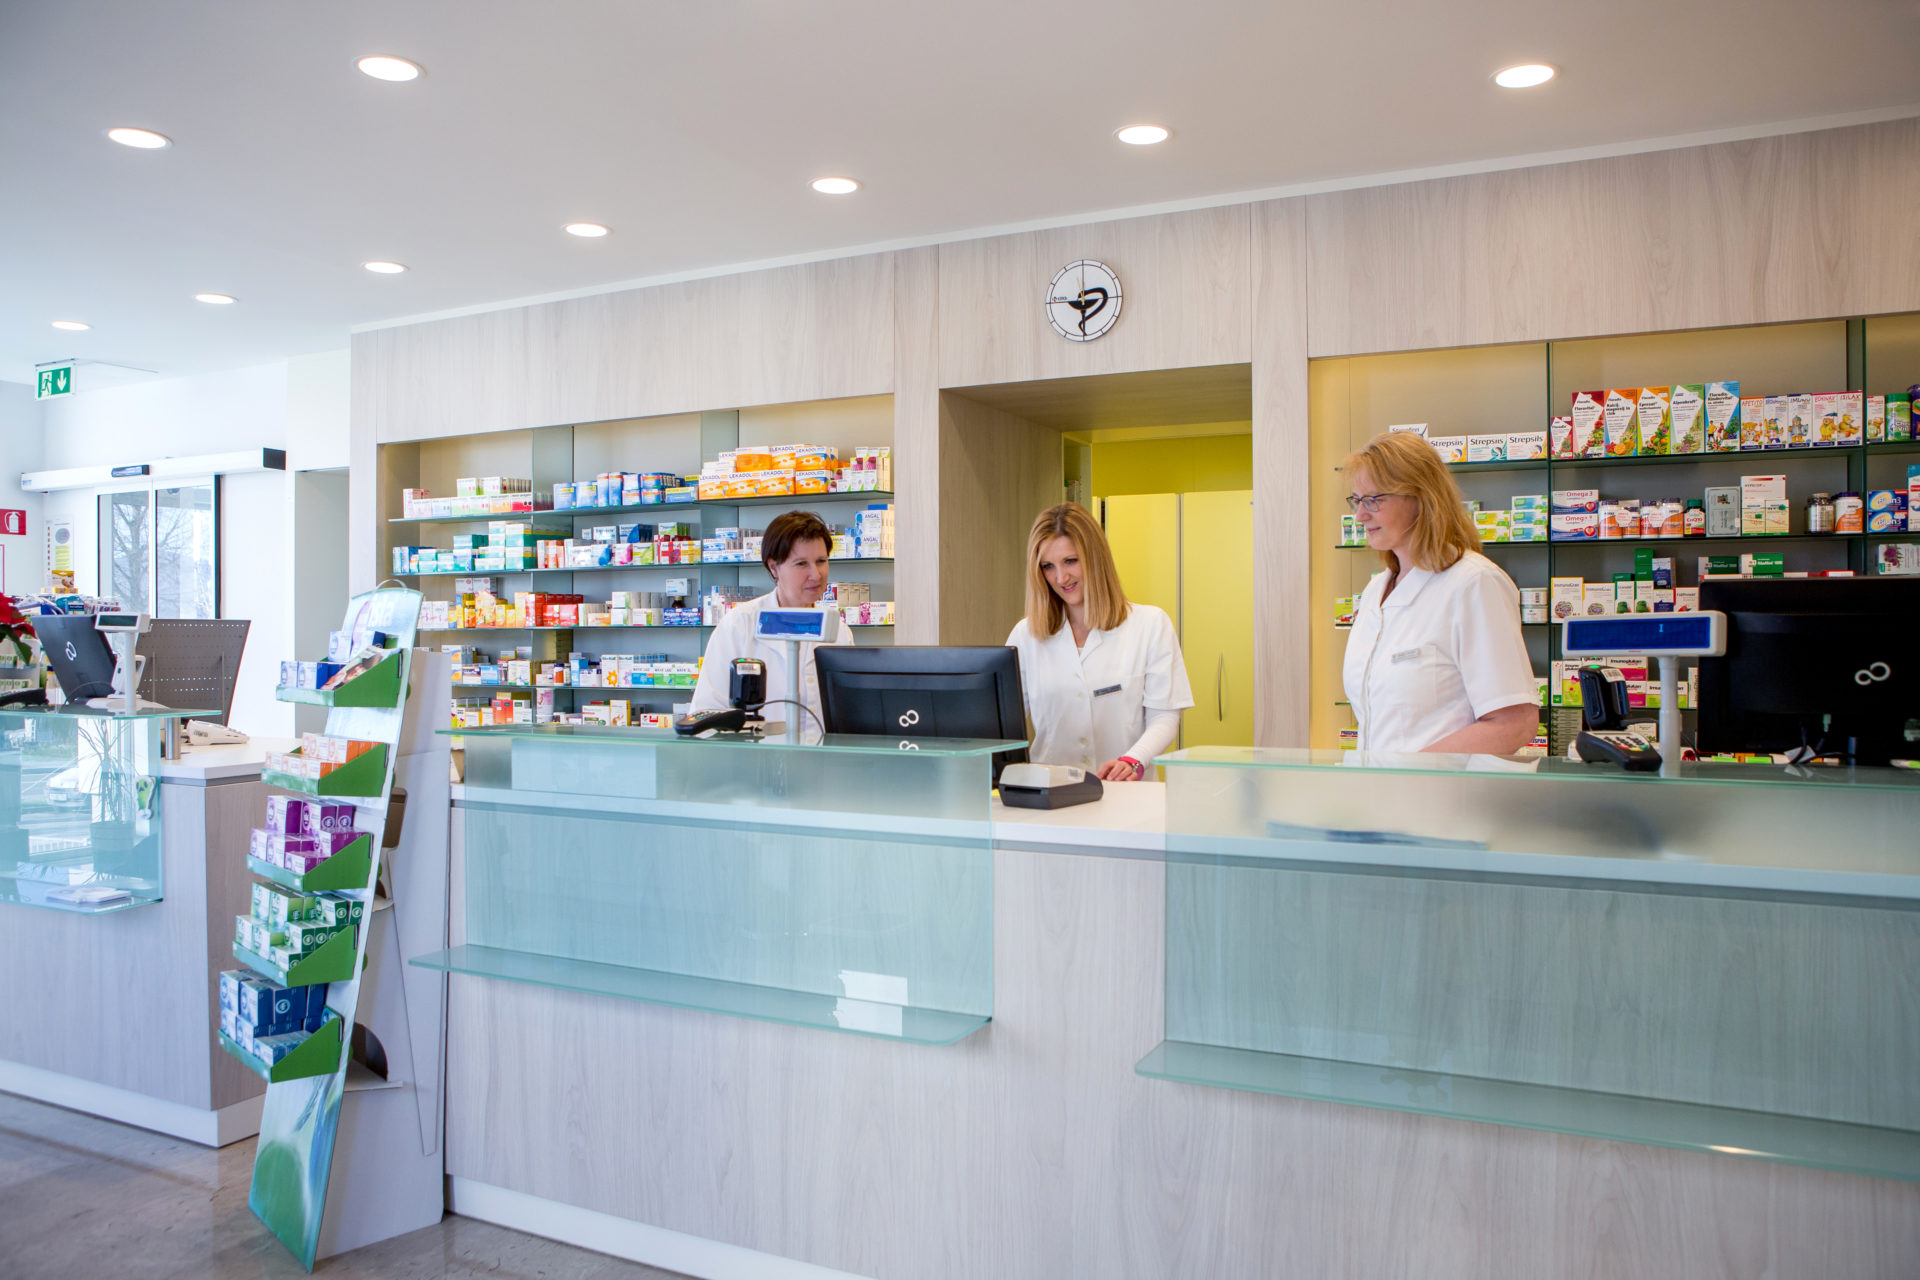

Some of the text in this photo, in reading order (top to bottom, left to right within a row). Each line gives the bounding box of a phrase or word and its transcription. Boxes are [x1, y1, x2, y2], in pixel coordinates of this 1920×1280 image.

[1431, 439, 1464, 448] Strepsils
[1470, 437, 1504, 446] Strepsils
[1509, 435, 1544, 444] Strepsils
